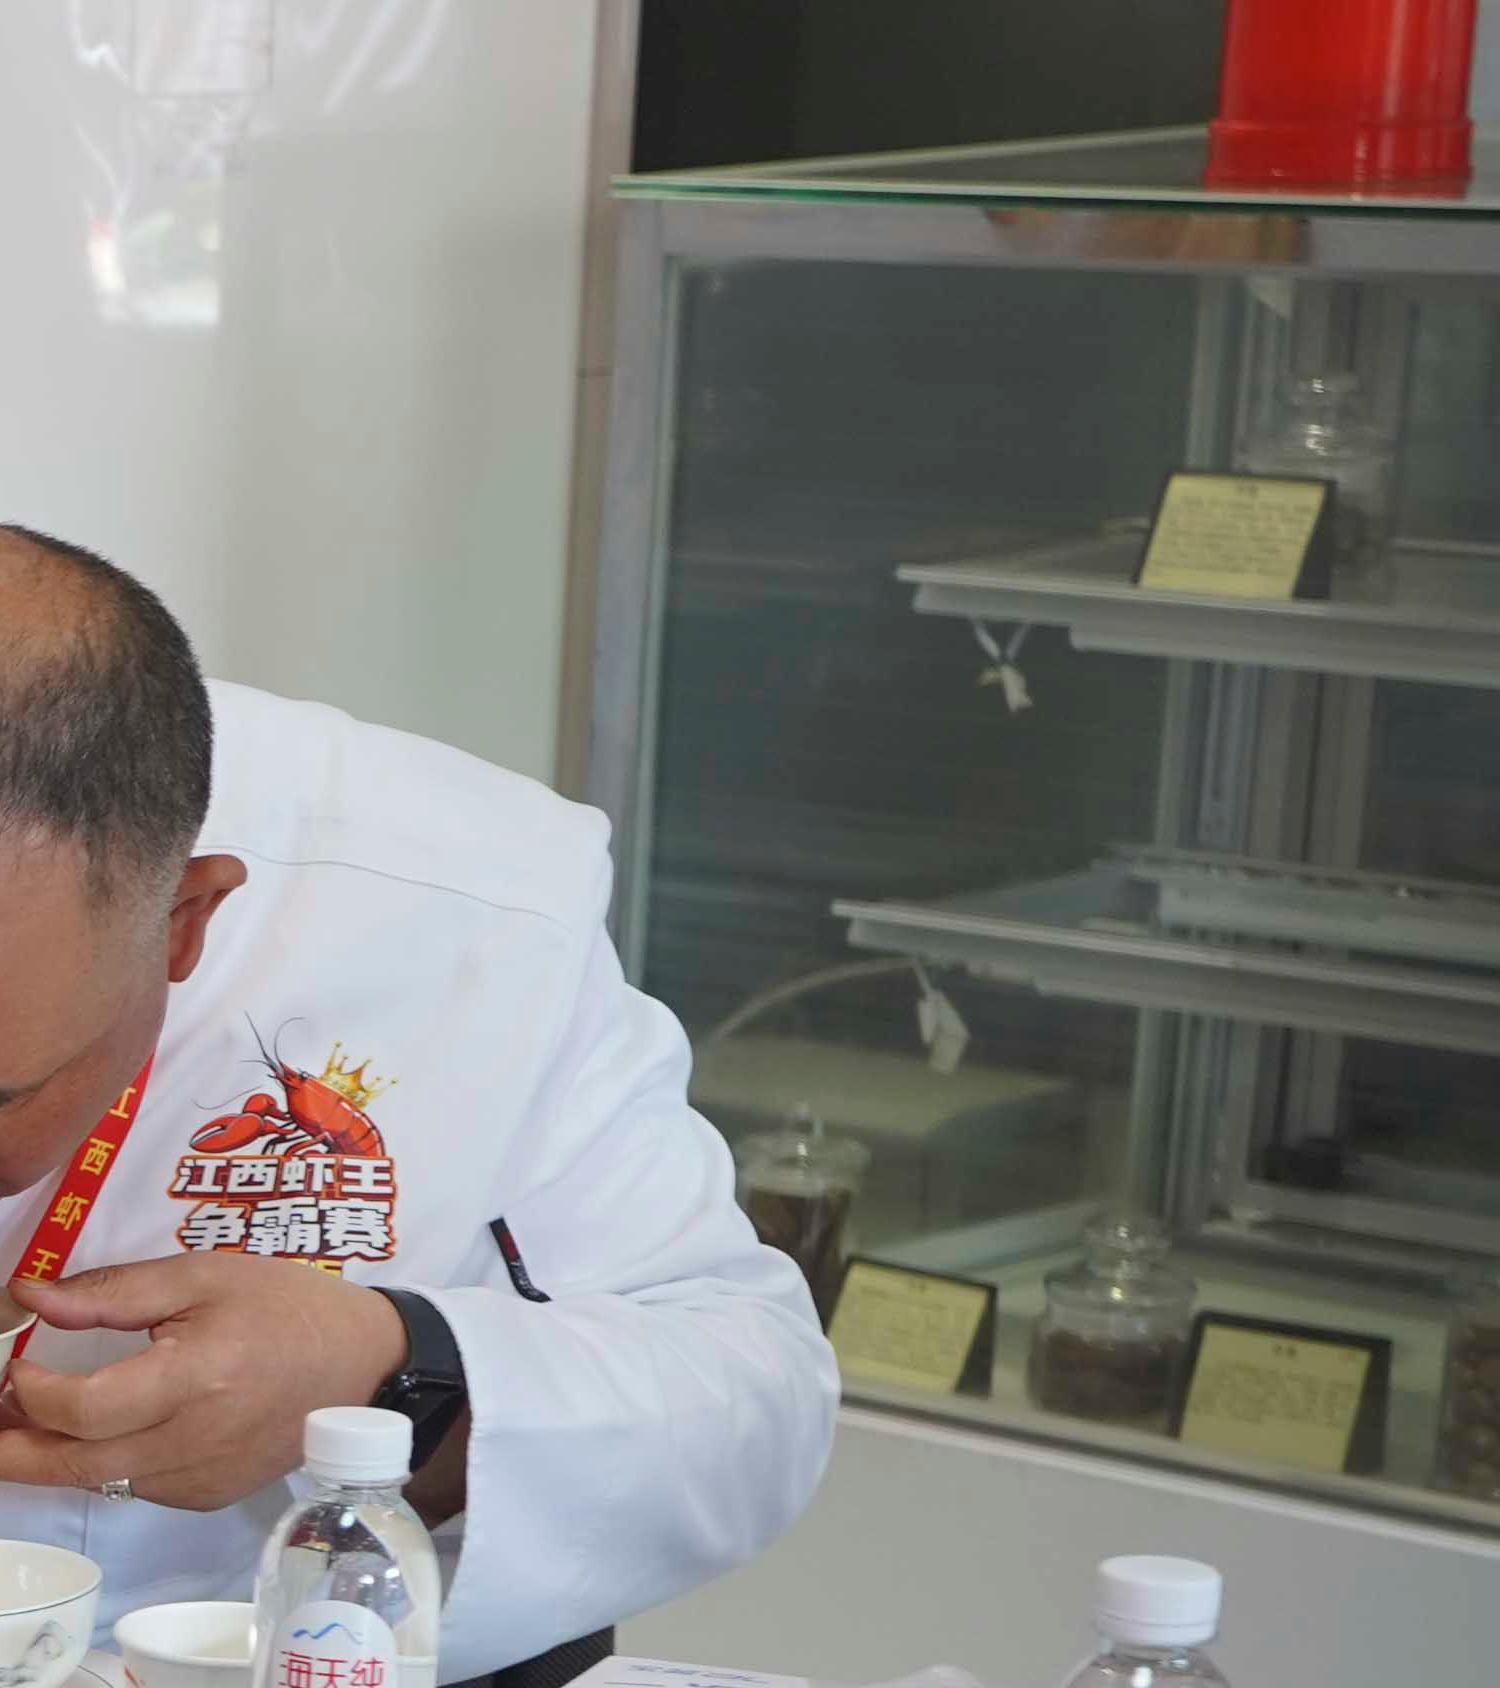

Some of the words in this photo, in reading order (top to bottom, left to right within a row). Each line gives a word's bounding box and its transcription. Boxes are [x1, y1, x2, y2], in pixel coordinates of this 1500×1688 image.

[171, 1156, 395, 1195] 江西虾王
[179, 1196, 396, 1257] 争霸赛
